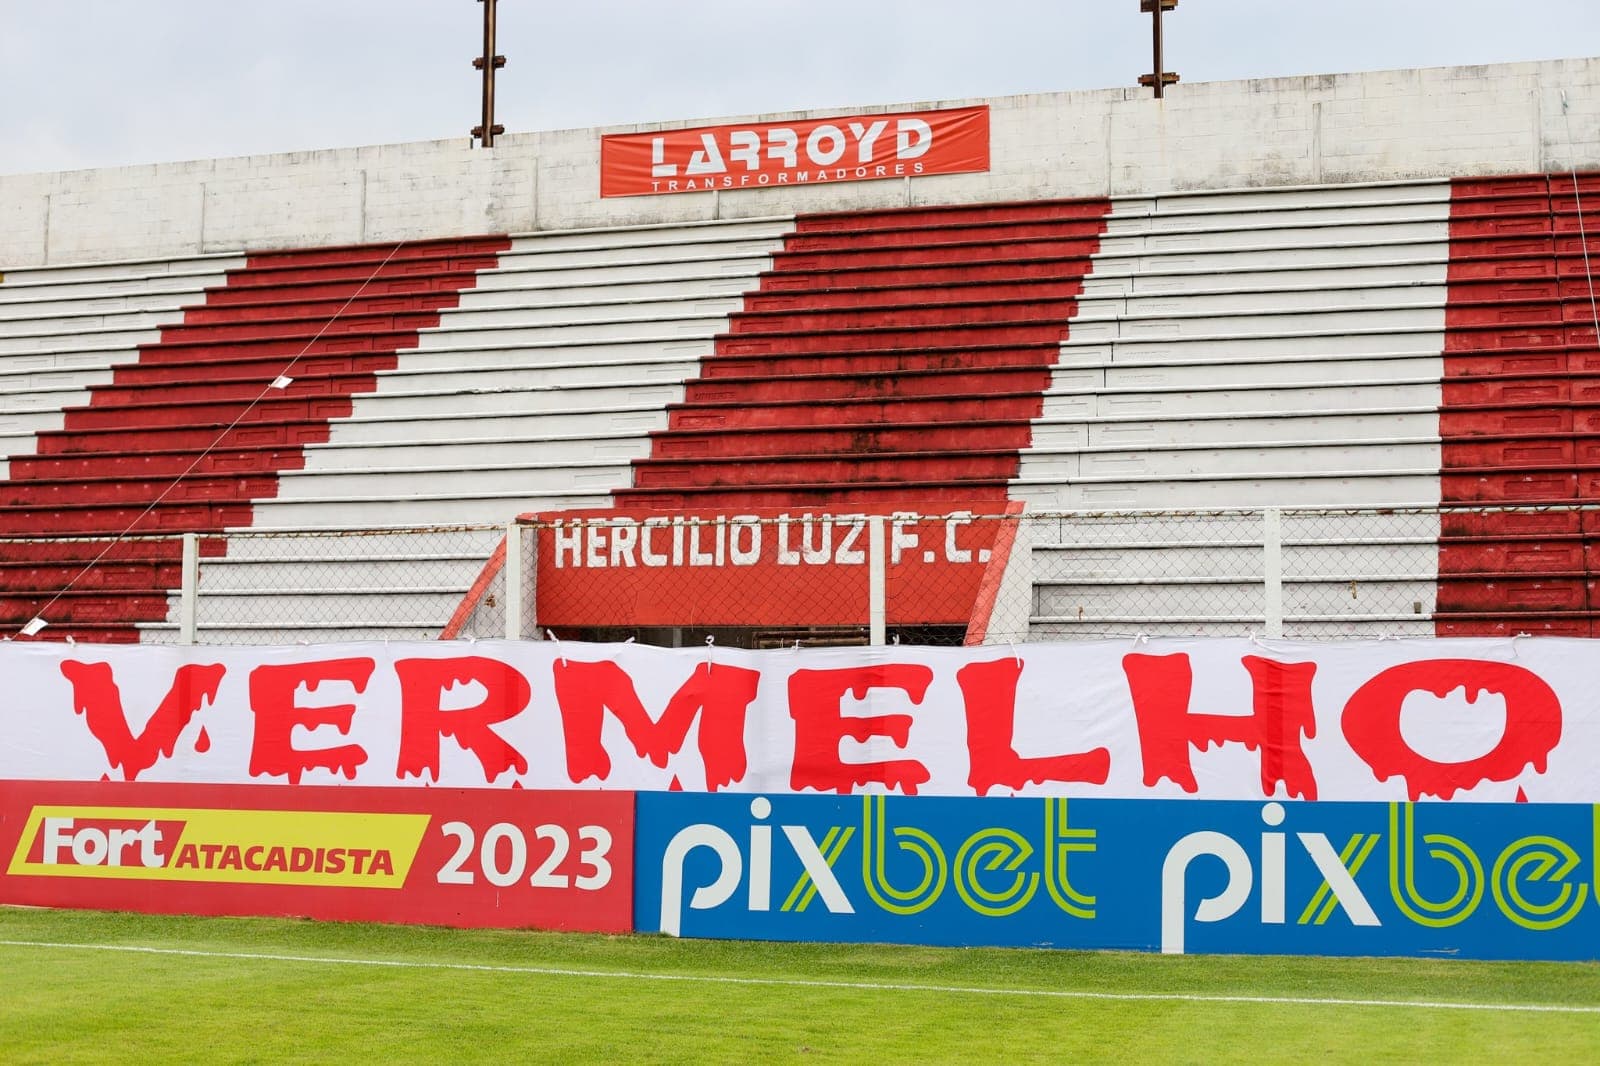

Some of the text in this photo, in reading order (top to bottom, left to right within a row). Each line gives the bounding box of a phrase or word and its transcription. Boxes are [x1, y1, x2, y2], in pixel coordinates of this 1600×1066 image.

[652, 118, 932, 178] LARROYD
[652, 162, 925, 193] TRANSFORMADORES
[554, 514, 762, 568] HERCILIO
[777, 512, 866, 566] LUZ
[60, 653, 1562, 802] VERMELHO
[43, 817, 395, 876] Fort ATACADISTA
[436, 821, 613, 890] 2023
[660, 794, 1097, 938] pixbet
[1161, 801, 1600, 954] pixbe
